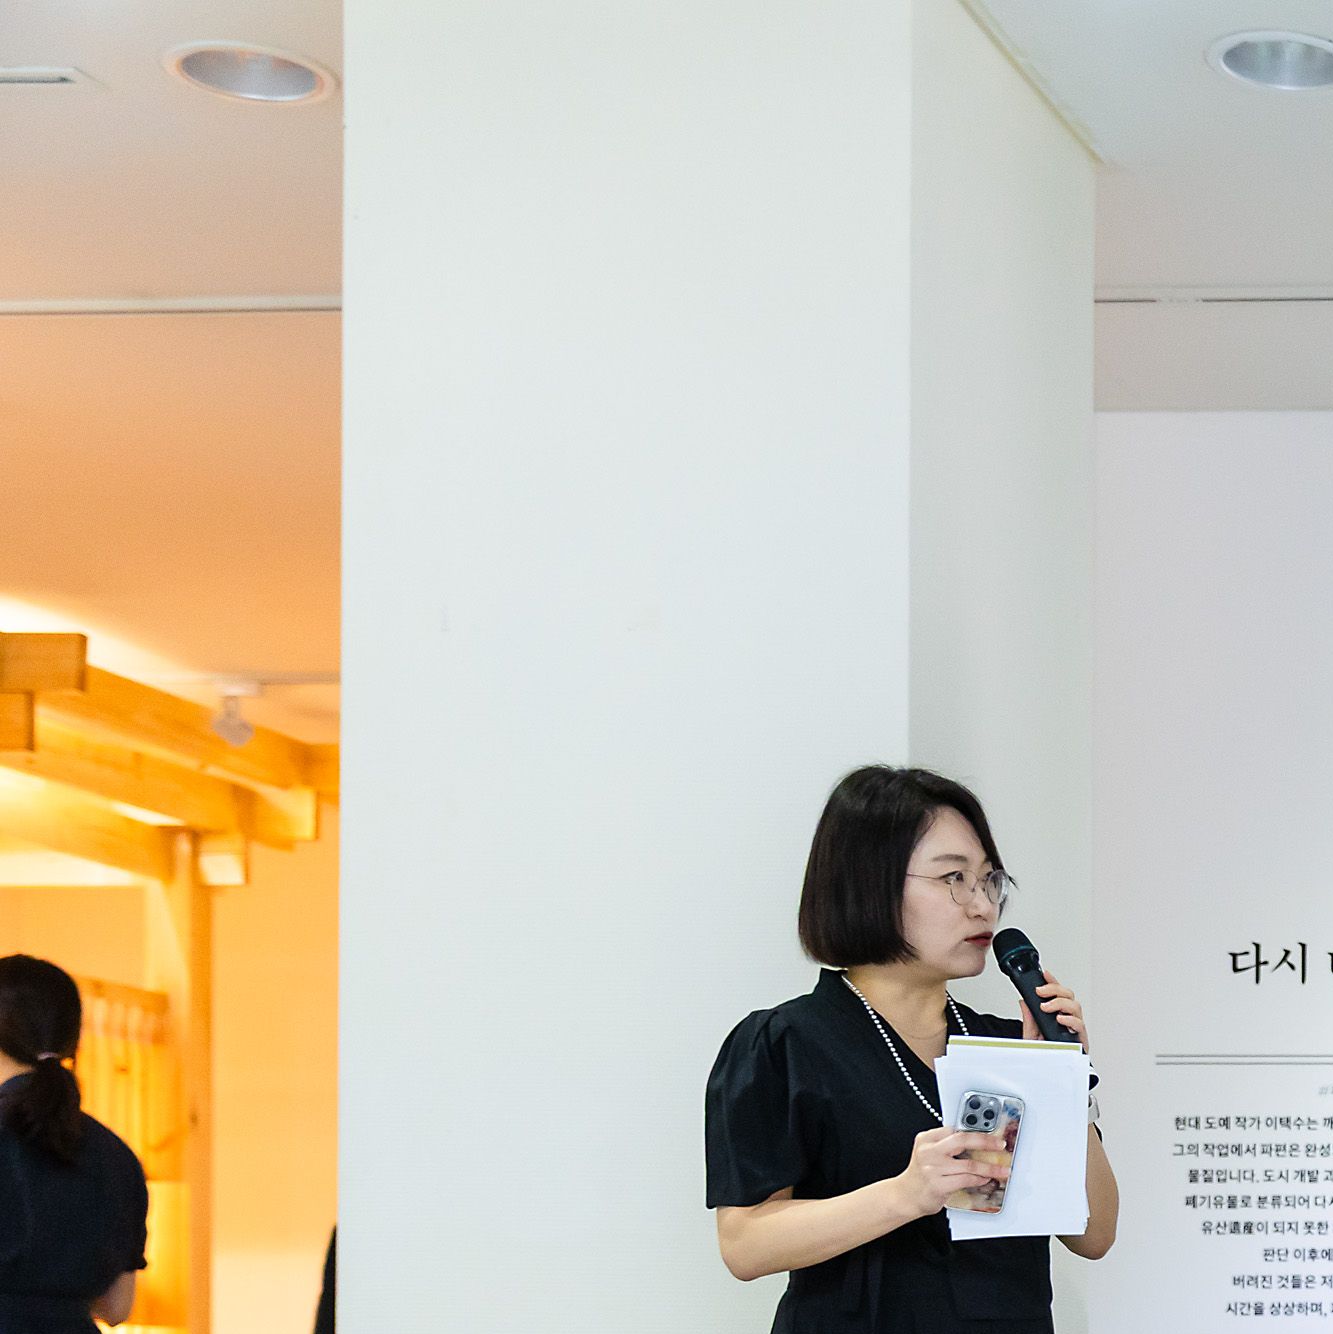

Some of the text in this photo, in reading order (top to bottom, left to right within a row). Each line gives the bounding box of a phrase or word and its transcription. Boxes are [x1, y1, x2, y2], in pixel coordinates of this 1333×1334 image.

[1228, 941, 1308, 985] 다시
[1175, 1116, 1201, 1131] 현대
[1204, 1116, 1231, 1130] 도예
[1235, 1116, 1261, 1131] 작가
[1265, 1116, 1319, 1131] 이택수는
[1173, 1143, 1199, 1157] 그의
[1203, 1143, 1256, 1158] 작업에서
[1260, 1143, 1301, 1158] 파편은
[1188, 1168, 1259, 1184] 물질입니다.
[1263, 1169, 1289, 1183] 도시
[1293, 1169, 1319, 1184] 개발
[1185, 1194, 1252, 1209] 폐기유물로
[1256, 1194, 1310, 1209] 분류되어
[1273, 1221, 1299, 1235] 되지
[1303, 1220, 1329, 1235] 못한
[1263, 1247, 1289, 1262] 판단
[1233, 1275, 1272, 1289] 버려진
[1277, 1274, 1317, 1289] 것들은
[1226, 1301, 1265, 1316] 시간을
[1269, 1302, 1327, 1317] 상상하며,
